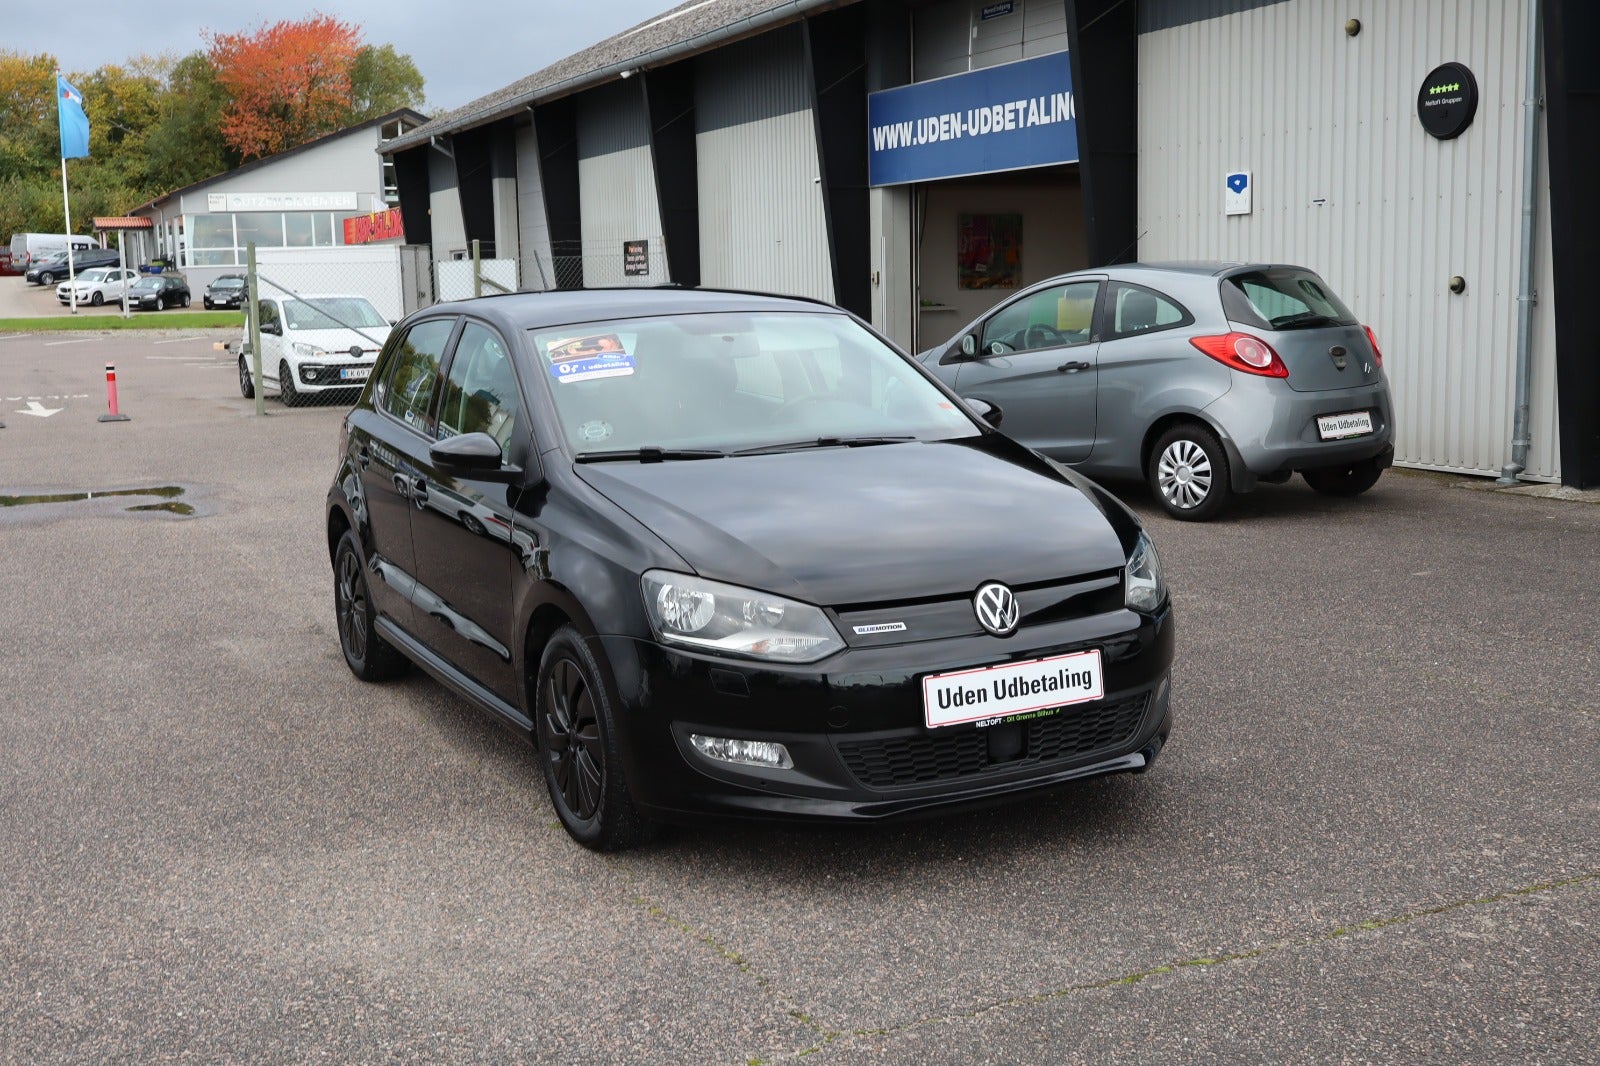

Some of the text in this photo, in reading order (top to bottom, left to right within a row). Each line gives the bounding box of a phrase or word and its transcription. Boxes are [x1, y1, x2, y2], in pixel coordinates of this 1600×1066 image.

[1441, 97, 1463, 105] Gruppen
[285, 196, 351, 207] BILCENTER
[1321, 417, 1370, 432] Uden Udbetaling
[857, 624, 903, 633] BLUEMOTION
[937, 668, 1092, 710] Uden Udbetaling
[975, 718, 1002, 728] NELTOFT
